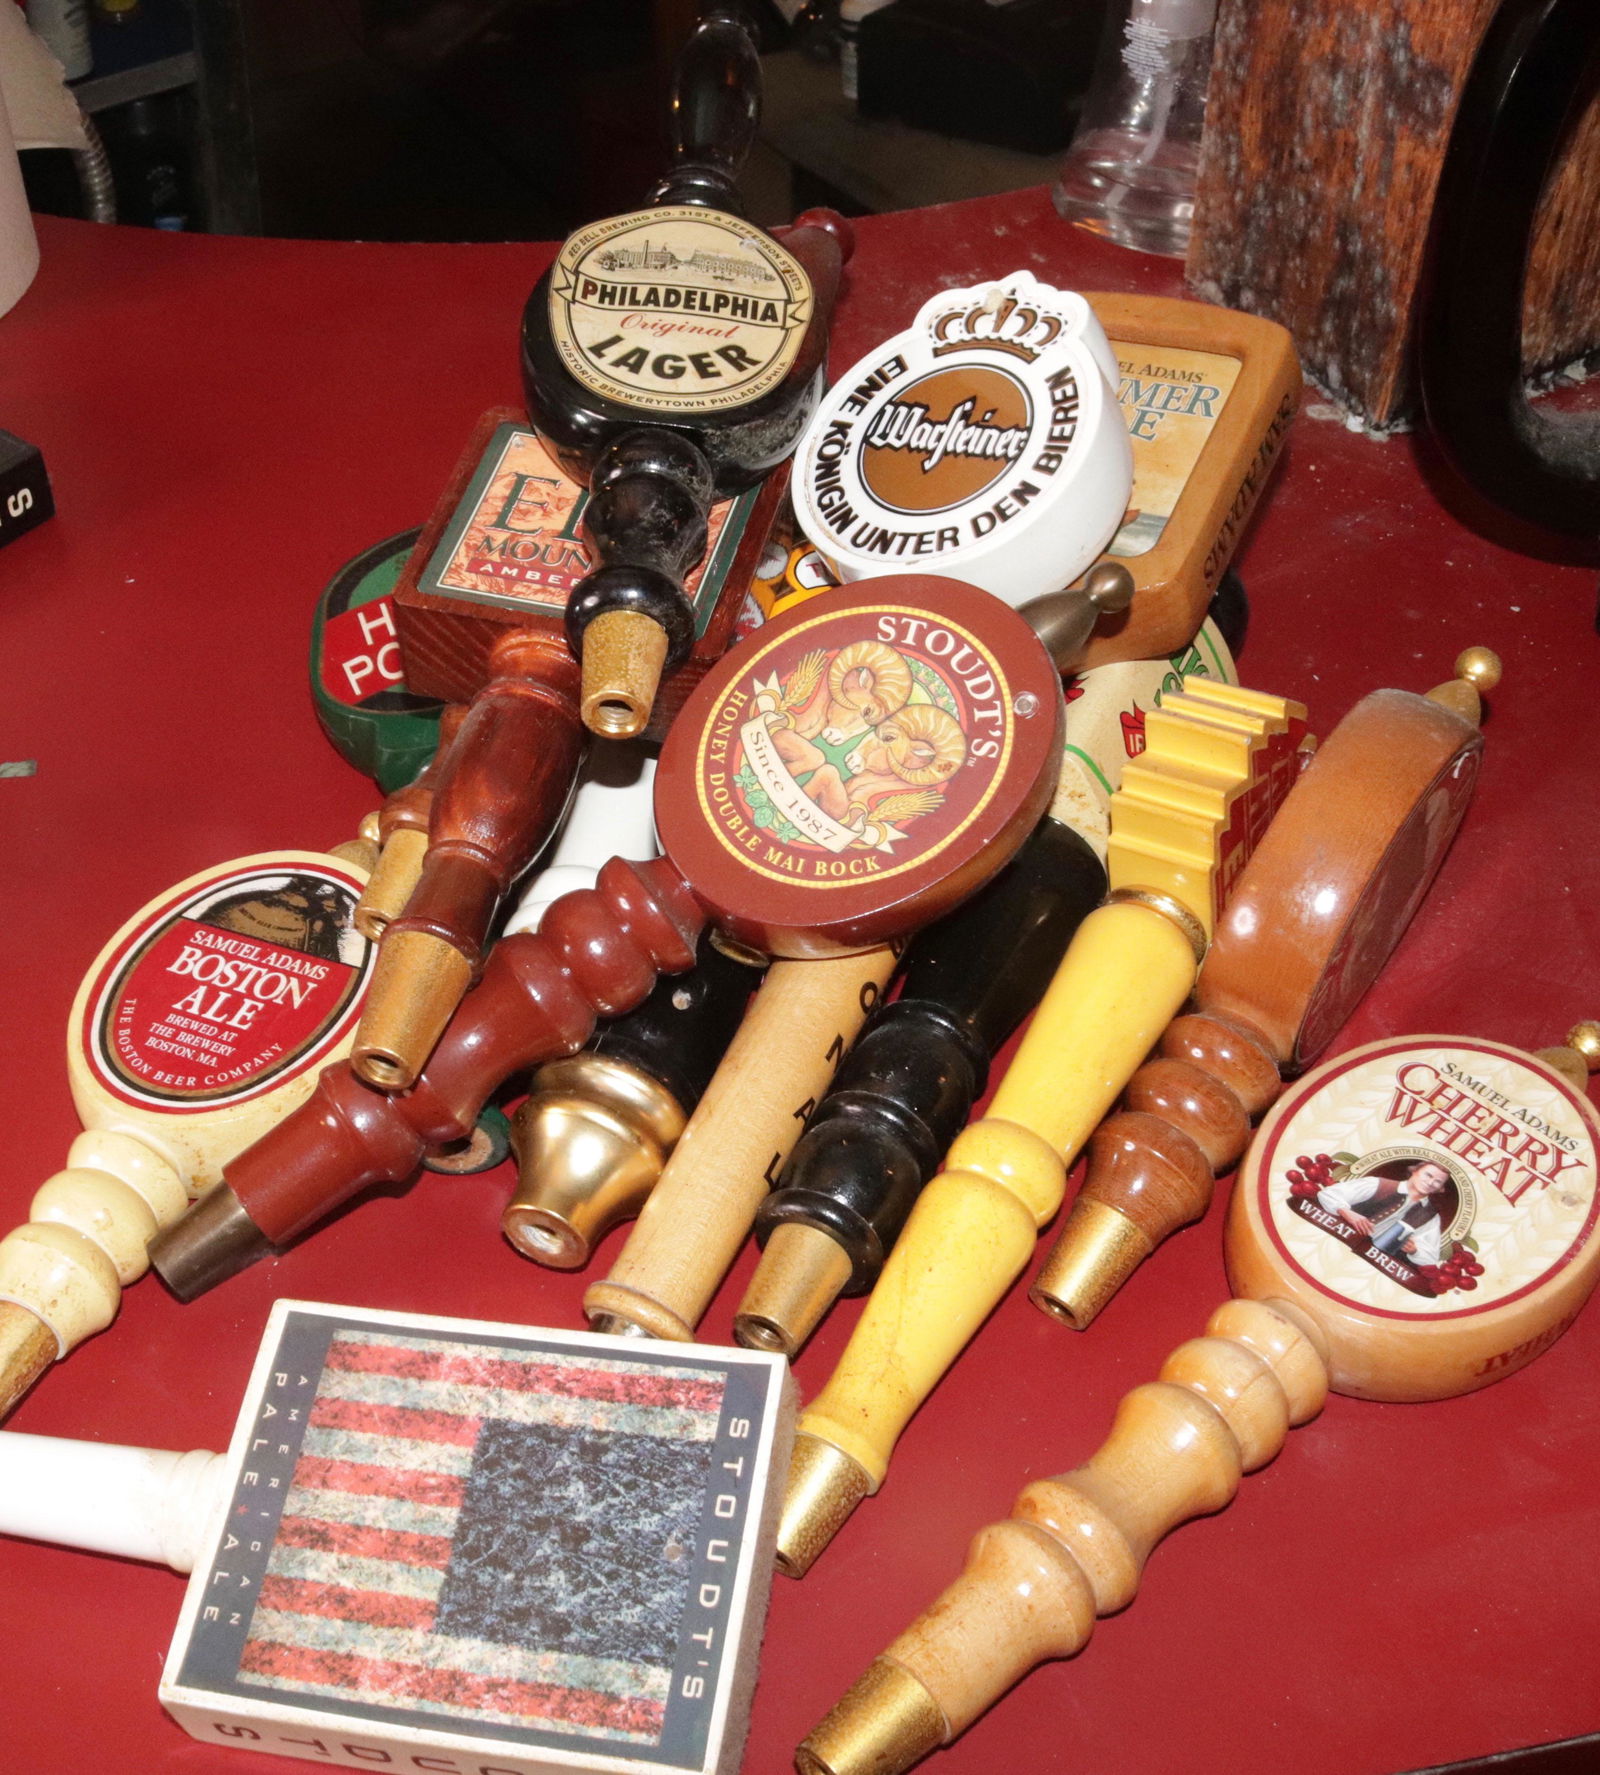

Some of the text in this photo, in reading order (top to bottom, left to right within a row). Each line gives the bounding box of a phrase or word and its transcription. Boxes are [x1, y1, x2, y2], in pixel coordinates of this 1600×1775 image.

[568, 245, 581, 258] RED
[580, 231, 600, 247] BELL
[599, 215, 651, 234] BREWING
[724, 221, 782, 260] JEFFERSON
[581, 281, 779, 323] PHILADELPHIA
[620, 312, 740, 339] Original
[560, 340, 788, 408] HISTORIC BREWERYTOWN PHILADELPHIA
[587, 334, 762, 380] LAGER
[1139, 363, 1204, 383] ADAMS
[814, 354, 1080, 556] EINE KÖNIGIN UNTER DEN BIEREN
[476, 535, 592, 574] MOUN
[709, 689, 881, 877] HONEY DOUBLE MAI BOCK
[750, 731, 838, 841] Since 1987
[166, 945, 318, 1010] BOSTON
[190, 930, 330, 981] SAMUEL ADAMS
[149, 1023, 236, 1057] THE BREWERY
[164, 1013, 239, 1043] BREWED AT
[171, 985, 265, 1031] ALE
[118, 998, 283, 1086] THE BOSTON BEER COMPANY
[1395, 1061, 1588, 1184] CHERRY
[1440, 1062, 1580, 1151] SAMUEL ADAMS
[1385, 1086, 1551, 1208] WHEAT
[1392, 1148, 1411, 1156] WITH
[1412, 1148, 1430, 1157] REAL
[1299, 1199, 1416, 1283] WHEAT BREW
[203, 1372, 288, 1622] PALE ALE
[230, 1374, 309, 1625] AMERICAN
[682, 1417, 750, 1699] STOUDT'S
